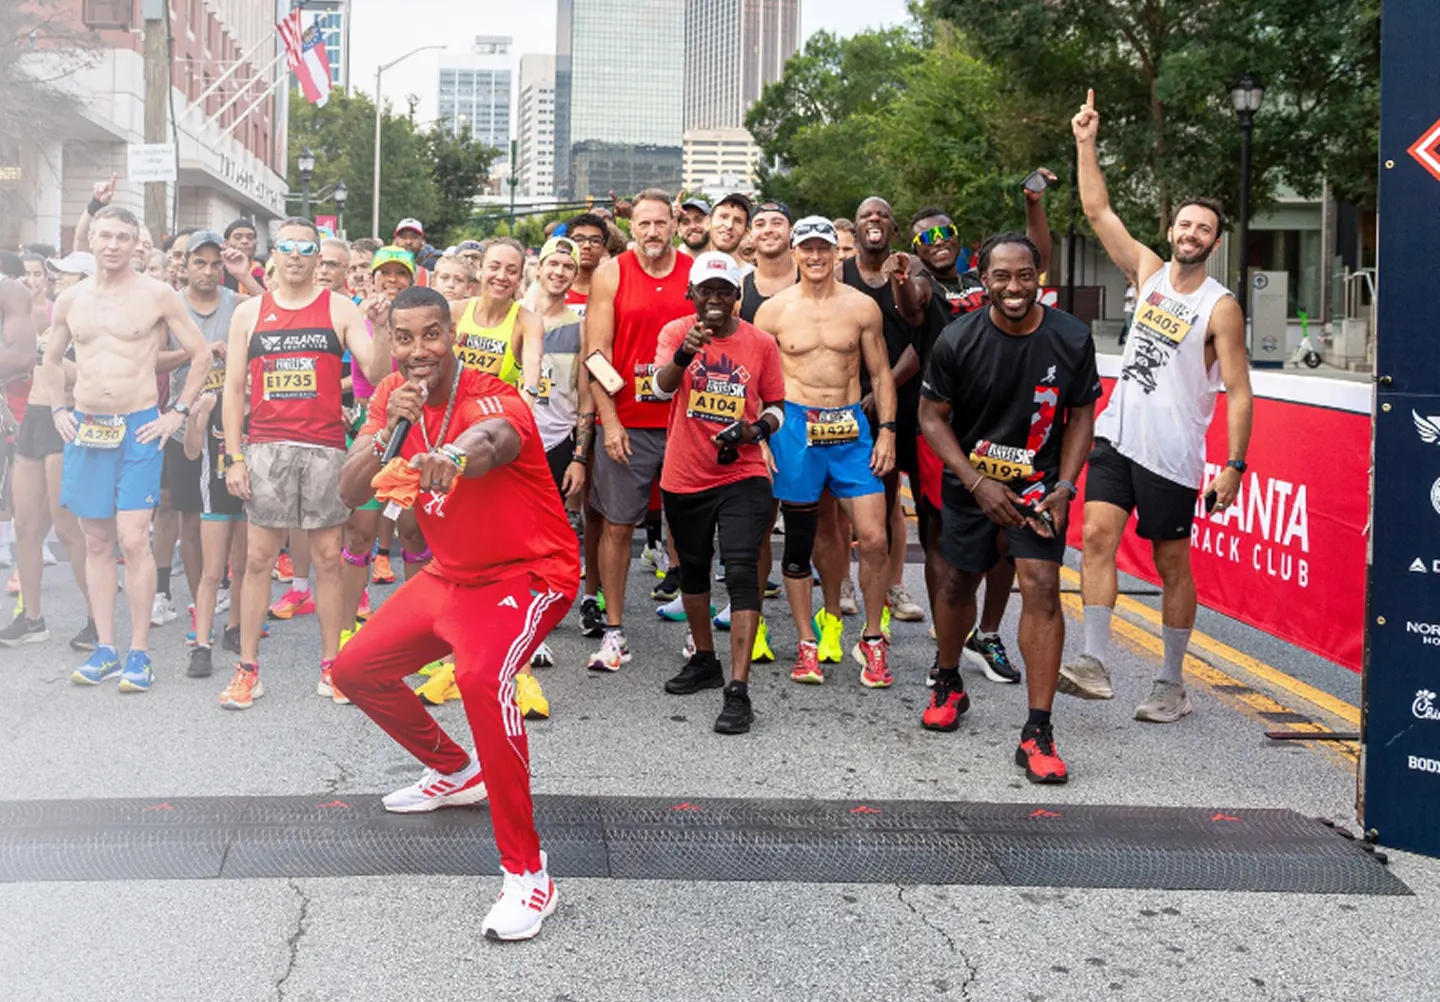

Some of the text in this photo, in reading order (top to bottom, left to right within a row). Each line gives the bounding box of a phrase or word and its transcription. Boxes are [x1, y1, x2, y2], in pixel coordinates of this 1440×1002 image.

[1142, 308, 1180, 335] A405
[284, 334, 328, 345] ATLANTA
[457, 350, 497, 368] A247
[266, 374, 312, 388] E1735
[695, 395, 737, 413] A104
[83, 428, 120, 441] A250
[976, 460, 1023, 480] A193
[1194, 462, 1310, 553] TLANTA
[1190, 523, 1309, 588] RACK CLUB
